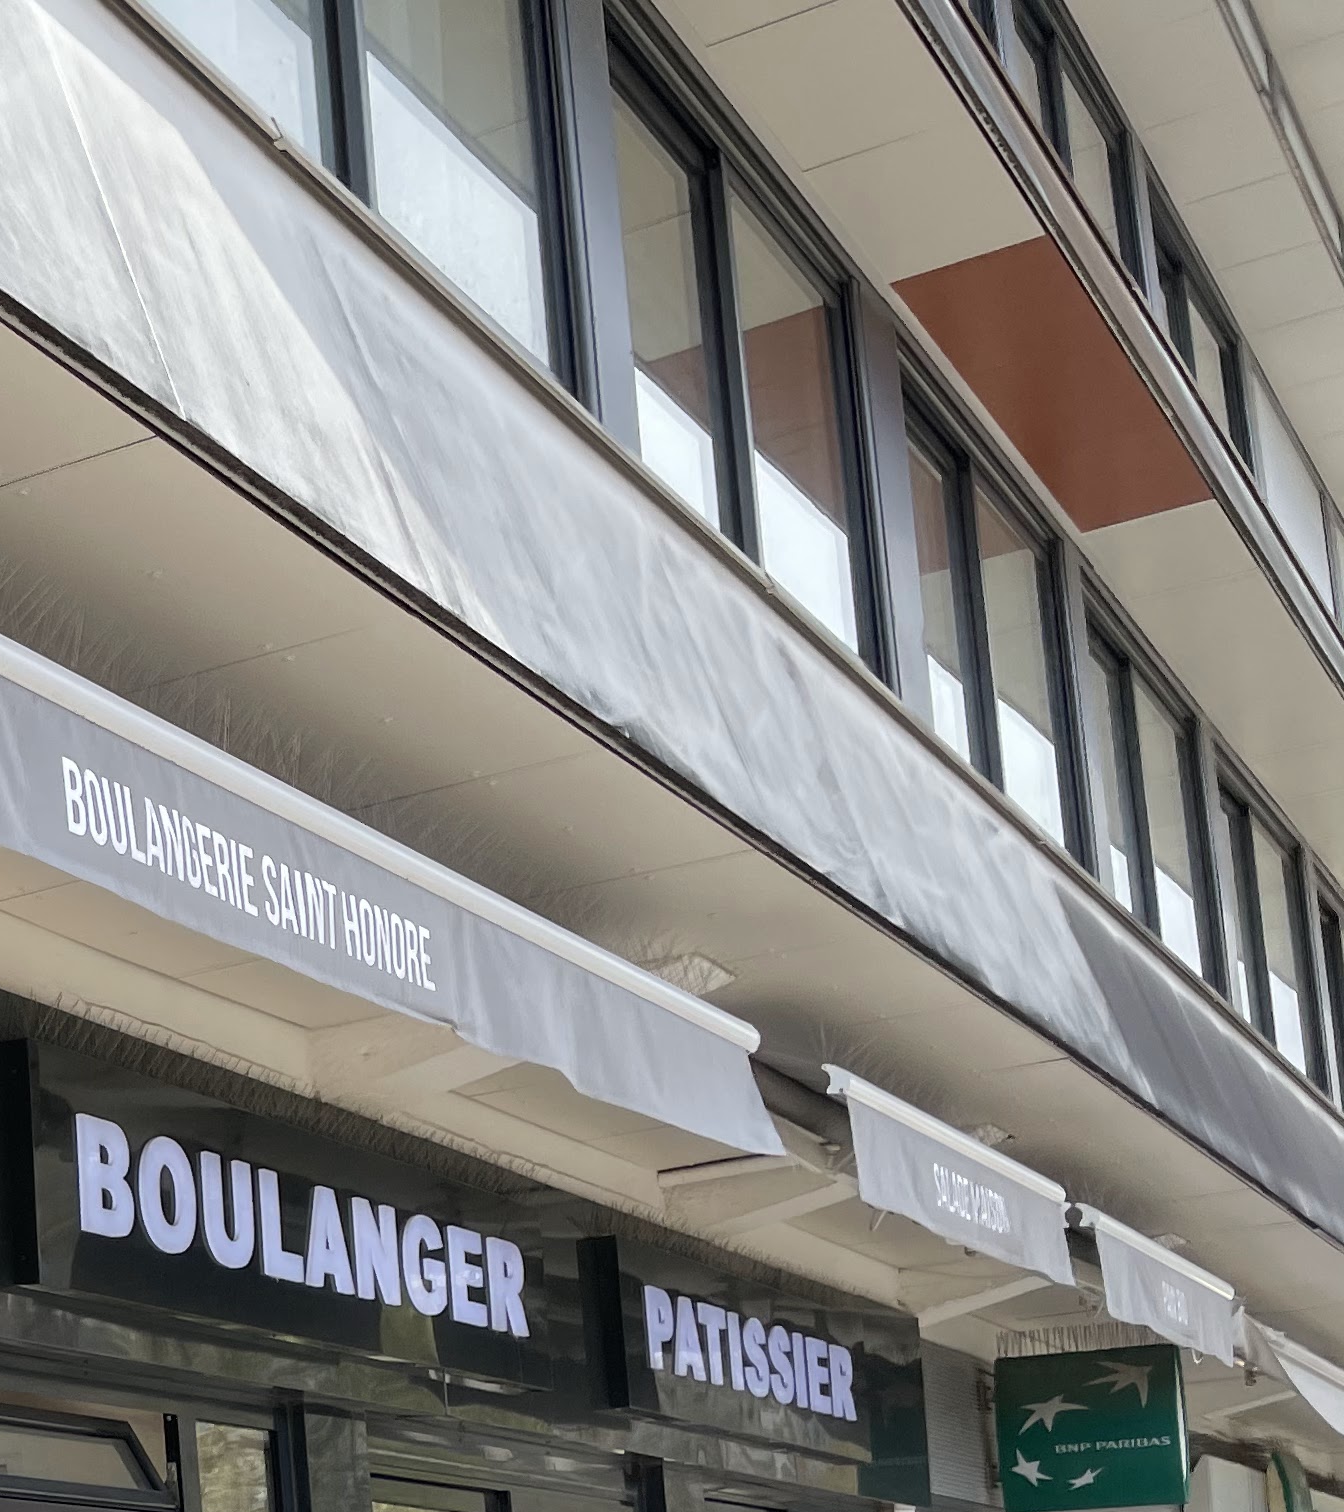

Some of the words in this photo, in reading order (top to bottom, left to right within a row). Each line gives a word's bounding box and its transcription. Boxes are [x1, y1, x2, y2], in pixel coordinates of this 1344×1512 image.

[61, 756, 260, 917] BOULANGERIE
[260, 854, 338, 950] SAINT
[341, 890, 437, 992] HONORE
[74, 1112, 531, 1338] BOULANGER
[643, 1284, 858, 1422] PATISSIER
[1055, 1442, 1092, 1454] BNP
[1095, 1435, 1172, 1452] PARIBAS
